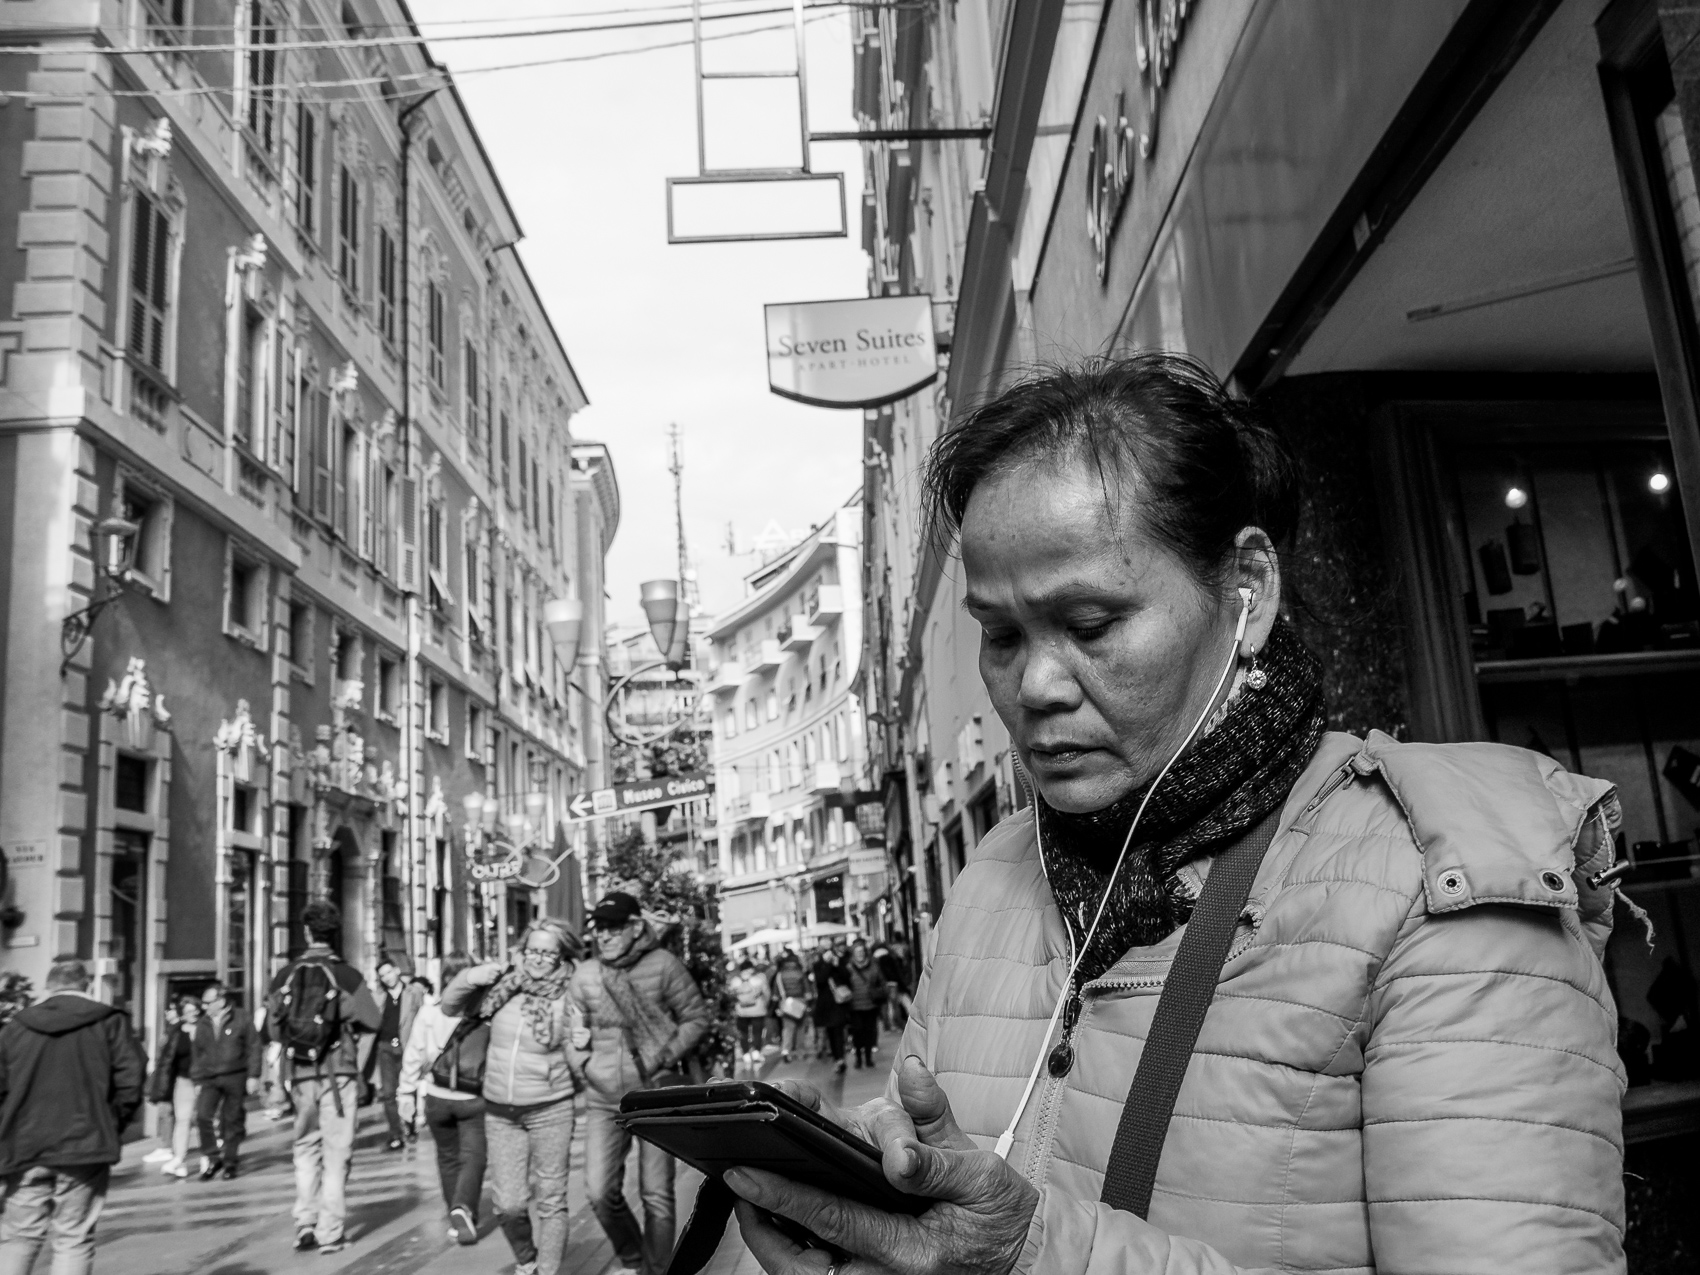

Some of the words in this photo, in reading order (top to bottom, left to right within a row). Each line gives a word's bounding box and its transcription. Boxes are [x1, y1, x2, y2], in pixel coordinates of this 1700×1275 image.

[778, 334, 846, 357] Seven
[856, 328, 925, 351] Suites
[622, 787, 663, 804] Museo
